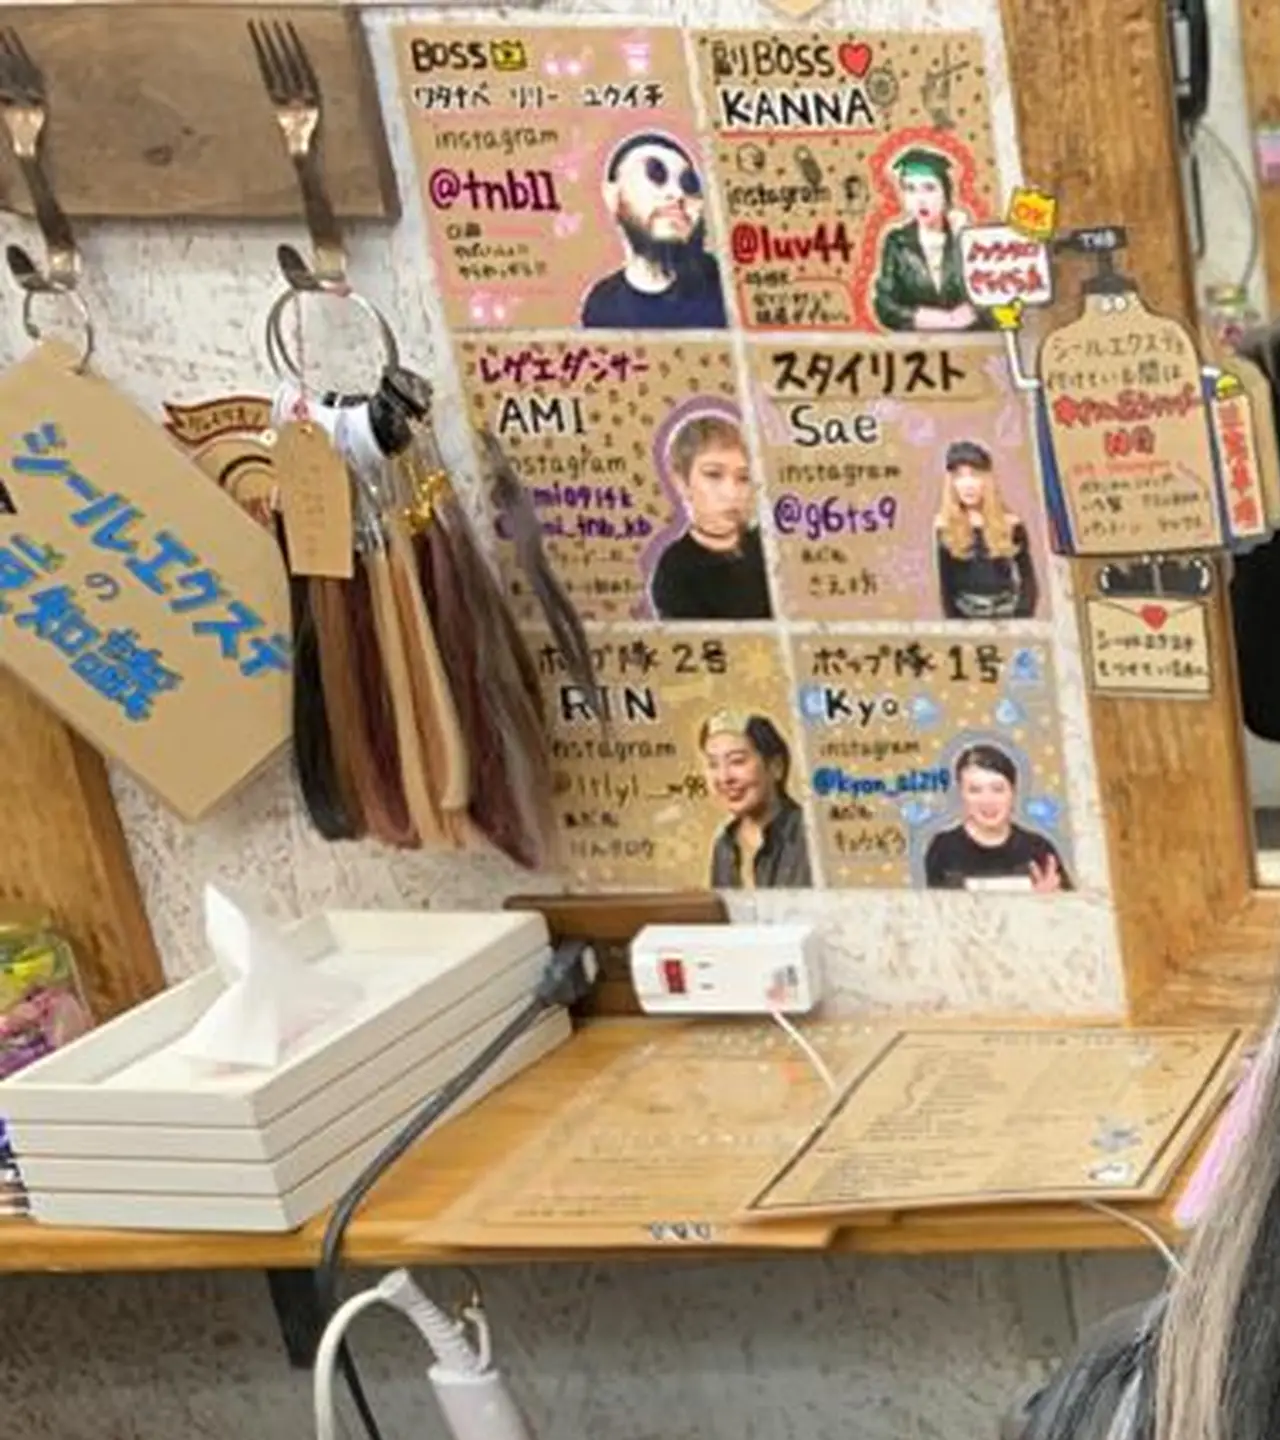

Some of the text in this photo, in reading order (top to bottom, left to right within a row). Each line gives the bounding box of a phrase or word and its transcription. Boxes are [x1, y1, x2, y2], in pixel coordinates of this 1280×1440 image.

[411, 38, 488, 72] BOSS
[722, 87, 874, 126] KANNA
[435, 127, 559, 155] instagram
[772, 351, 966, 395] スタイリスト
[499, 397, 585, 435] AMI
[790, 404, 878, 447] Sae
[824, 687, 899, 727] Kyo
